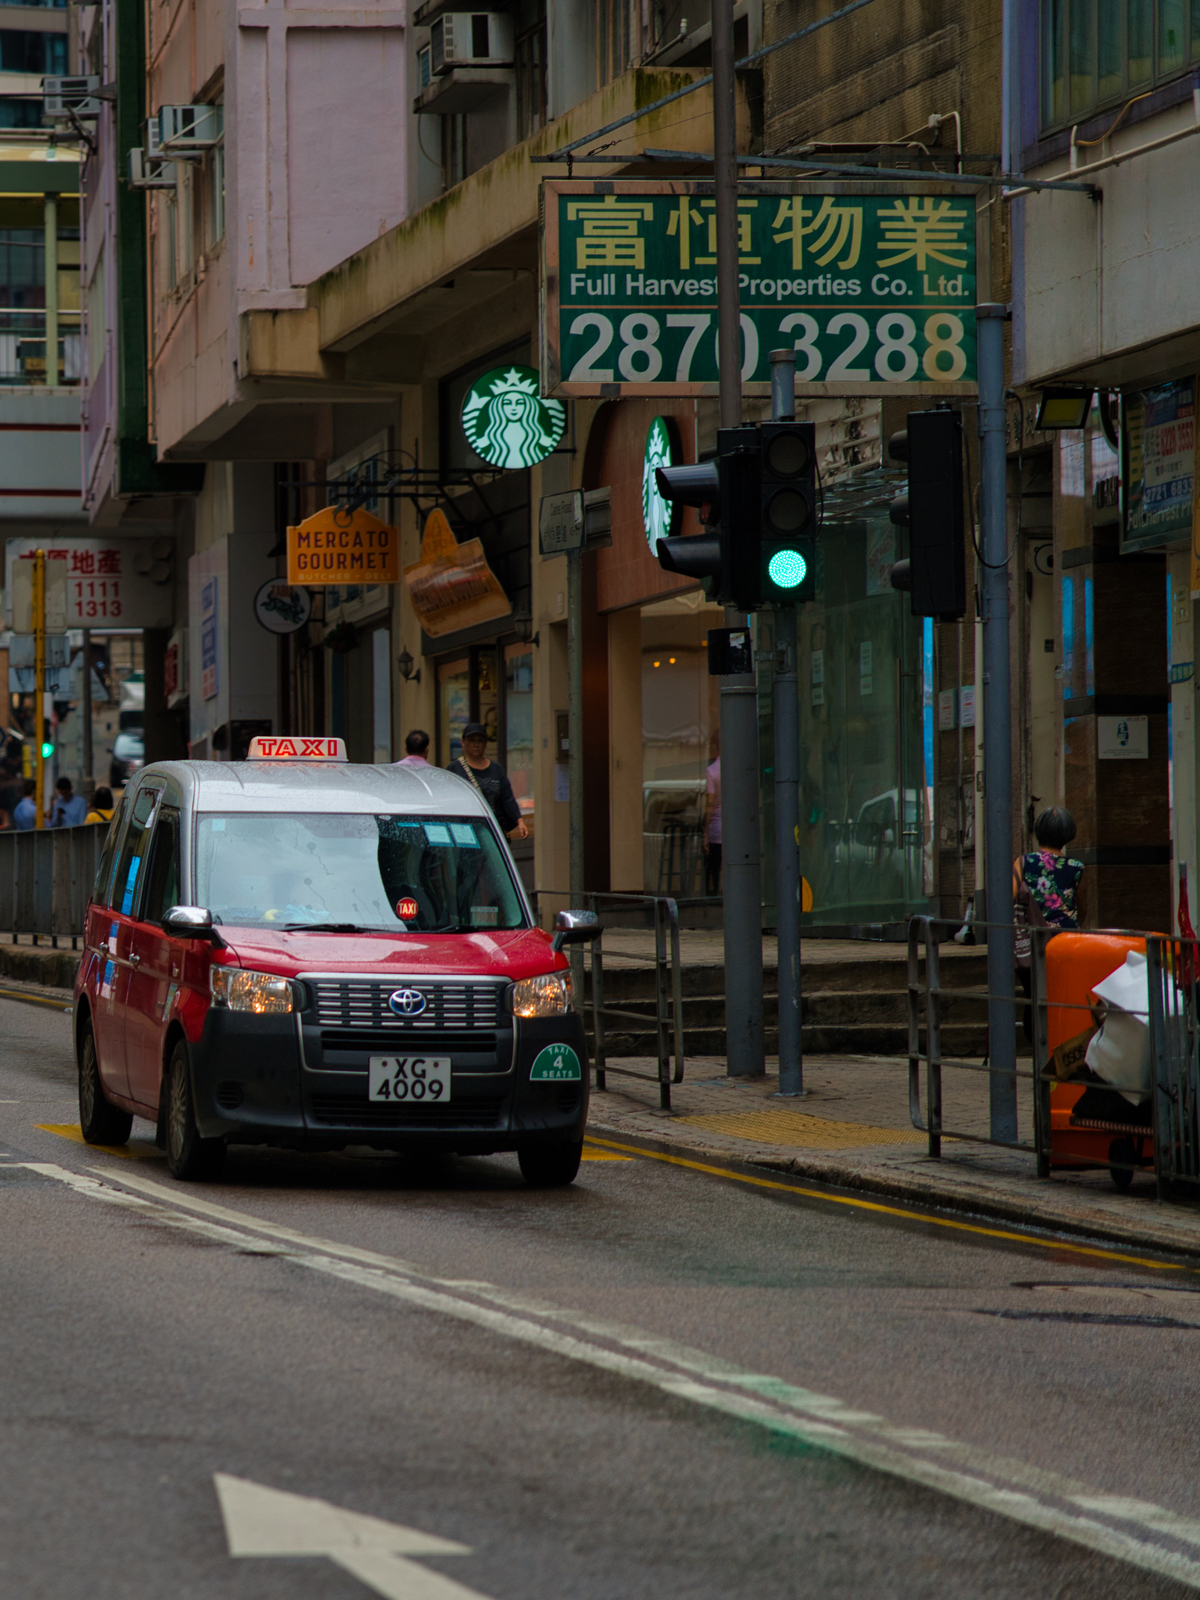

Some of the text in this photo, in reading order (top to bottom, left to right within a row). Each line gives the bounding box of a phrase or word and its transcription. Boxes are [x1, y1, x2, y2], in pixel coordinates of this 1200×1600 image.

[566, 195, 968, 271] 富恒物業
[570, 273, 616, 296] Full
[870, 273, 913, 296] Co.
[923, 273, 969, 296] Ltd.
[568, 312, 968, 382] 2870 3288
[297, 531, 389, 548] MERCATO
[297, 552, 390, 569] GOURMET
[298, 572, 391, 581] BUTCHER DELI
[75, 601, 122, 617] 1313
[257, 738, 338, 757] TAXI
[398, 902, 417, 912] TAXI
[547, 1045, 569, 1056] TAXI
[394, 1058, 427, 1079] XG
[553, 1055, 564, 1070] 4
[542, 1070, 573, 1078] SEATS
[376, 1079, 443, 1100] 4009
